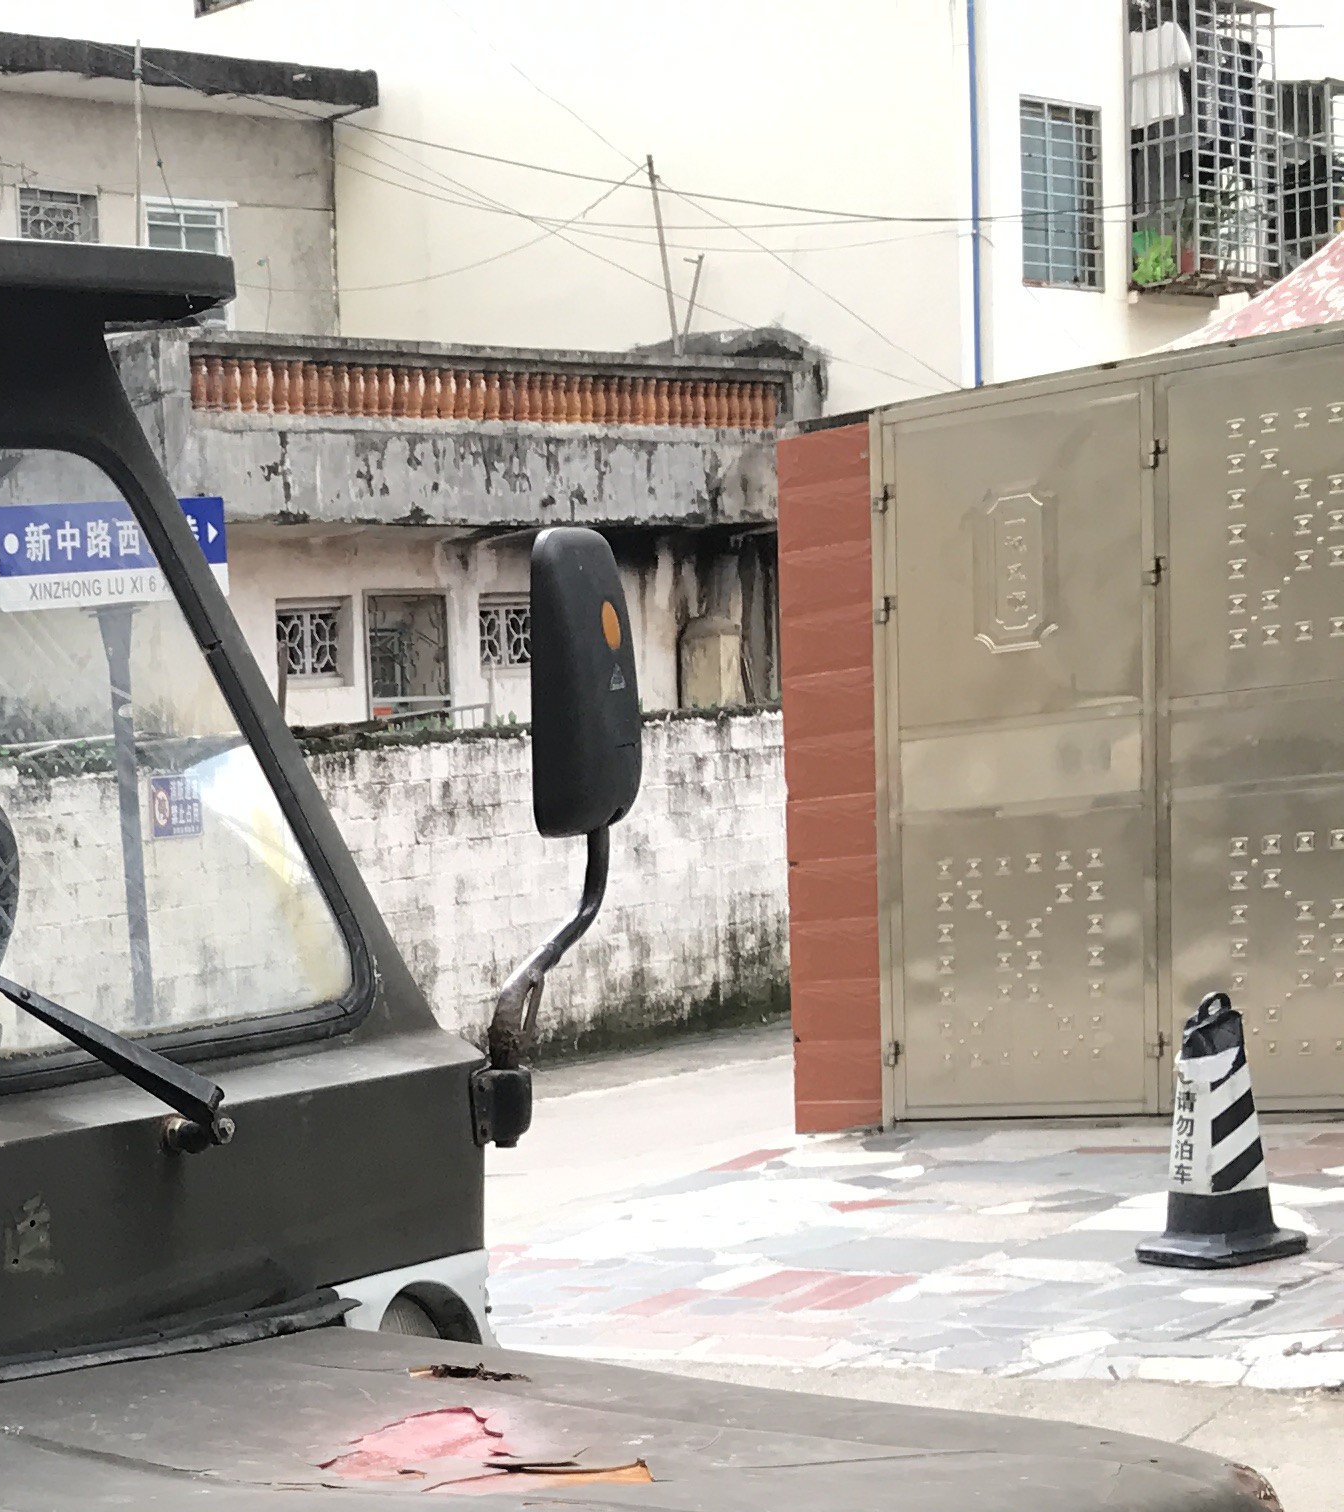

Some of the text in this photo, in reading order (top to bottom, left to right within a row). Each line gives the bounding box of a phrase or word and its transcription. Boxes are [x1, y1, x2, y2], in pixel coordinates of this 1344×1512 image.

[28, 578, 102, 601] XINZHONG
[108, 577, 125, 595] LU
[130, 575, 144, 594] XI
[148, 575, 157, 593] 6
[1173, 1090, 1197, 1185] 请勿泊车
